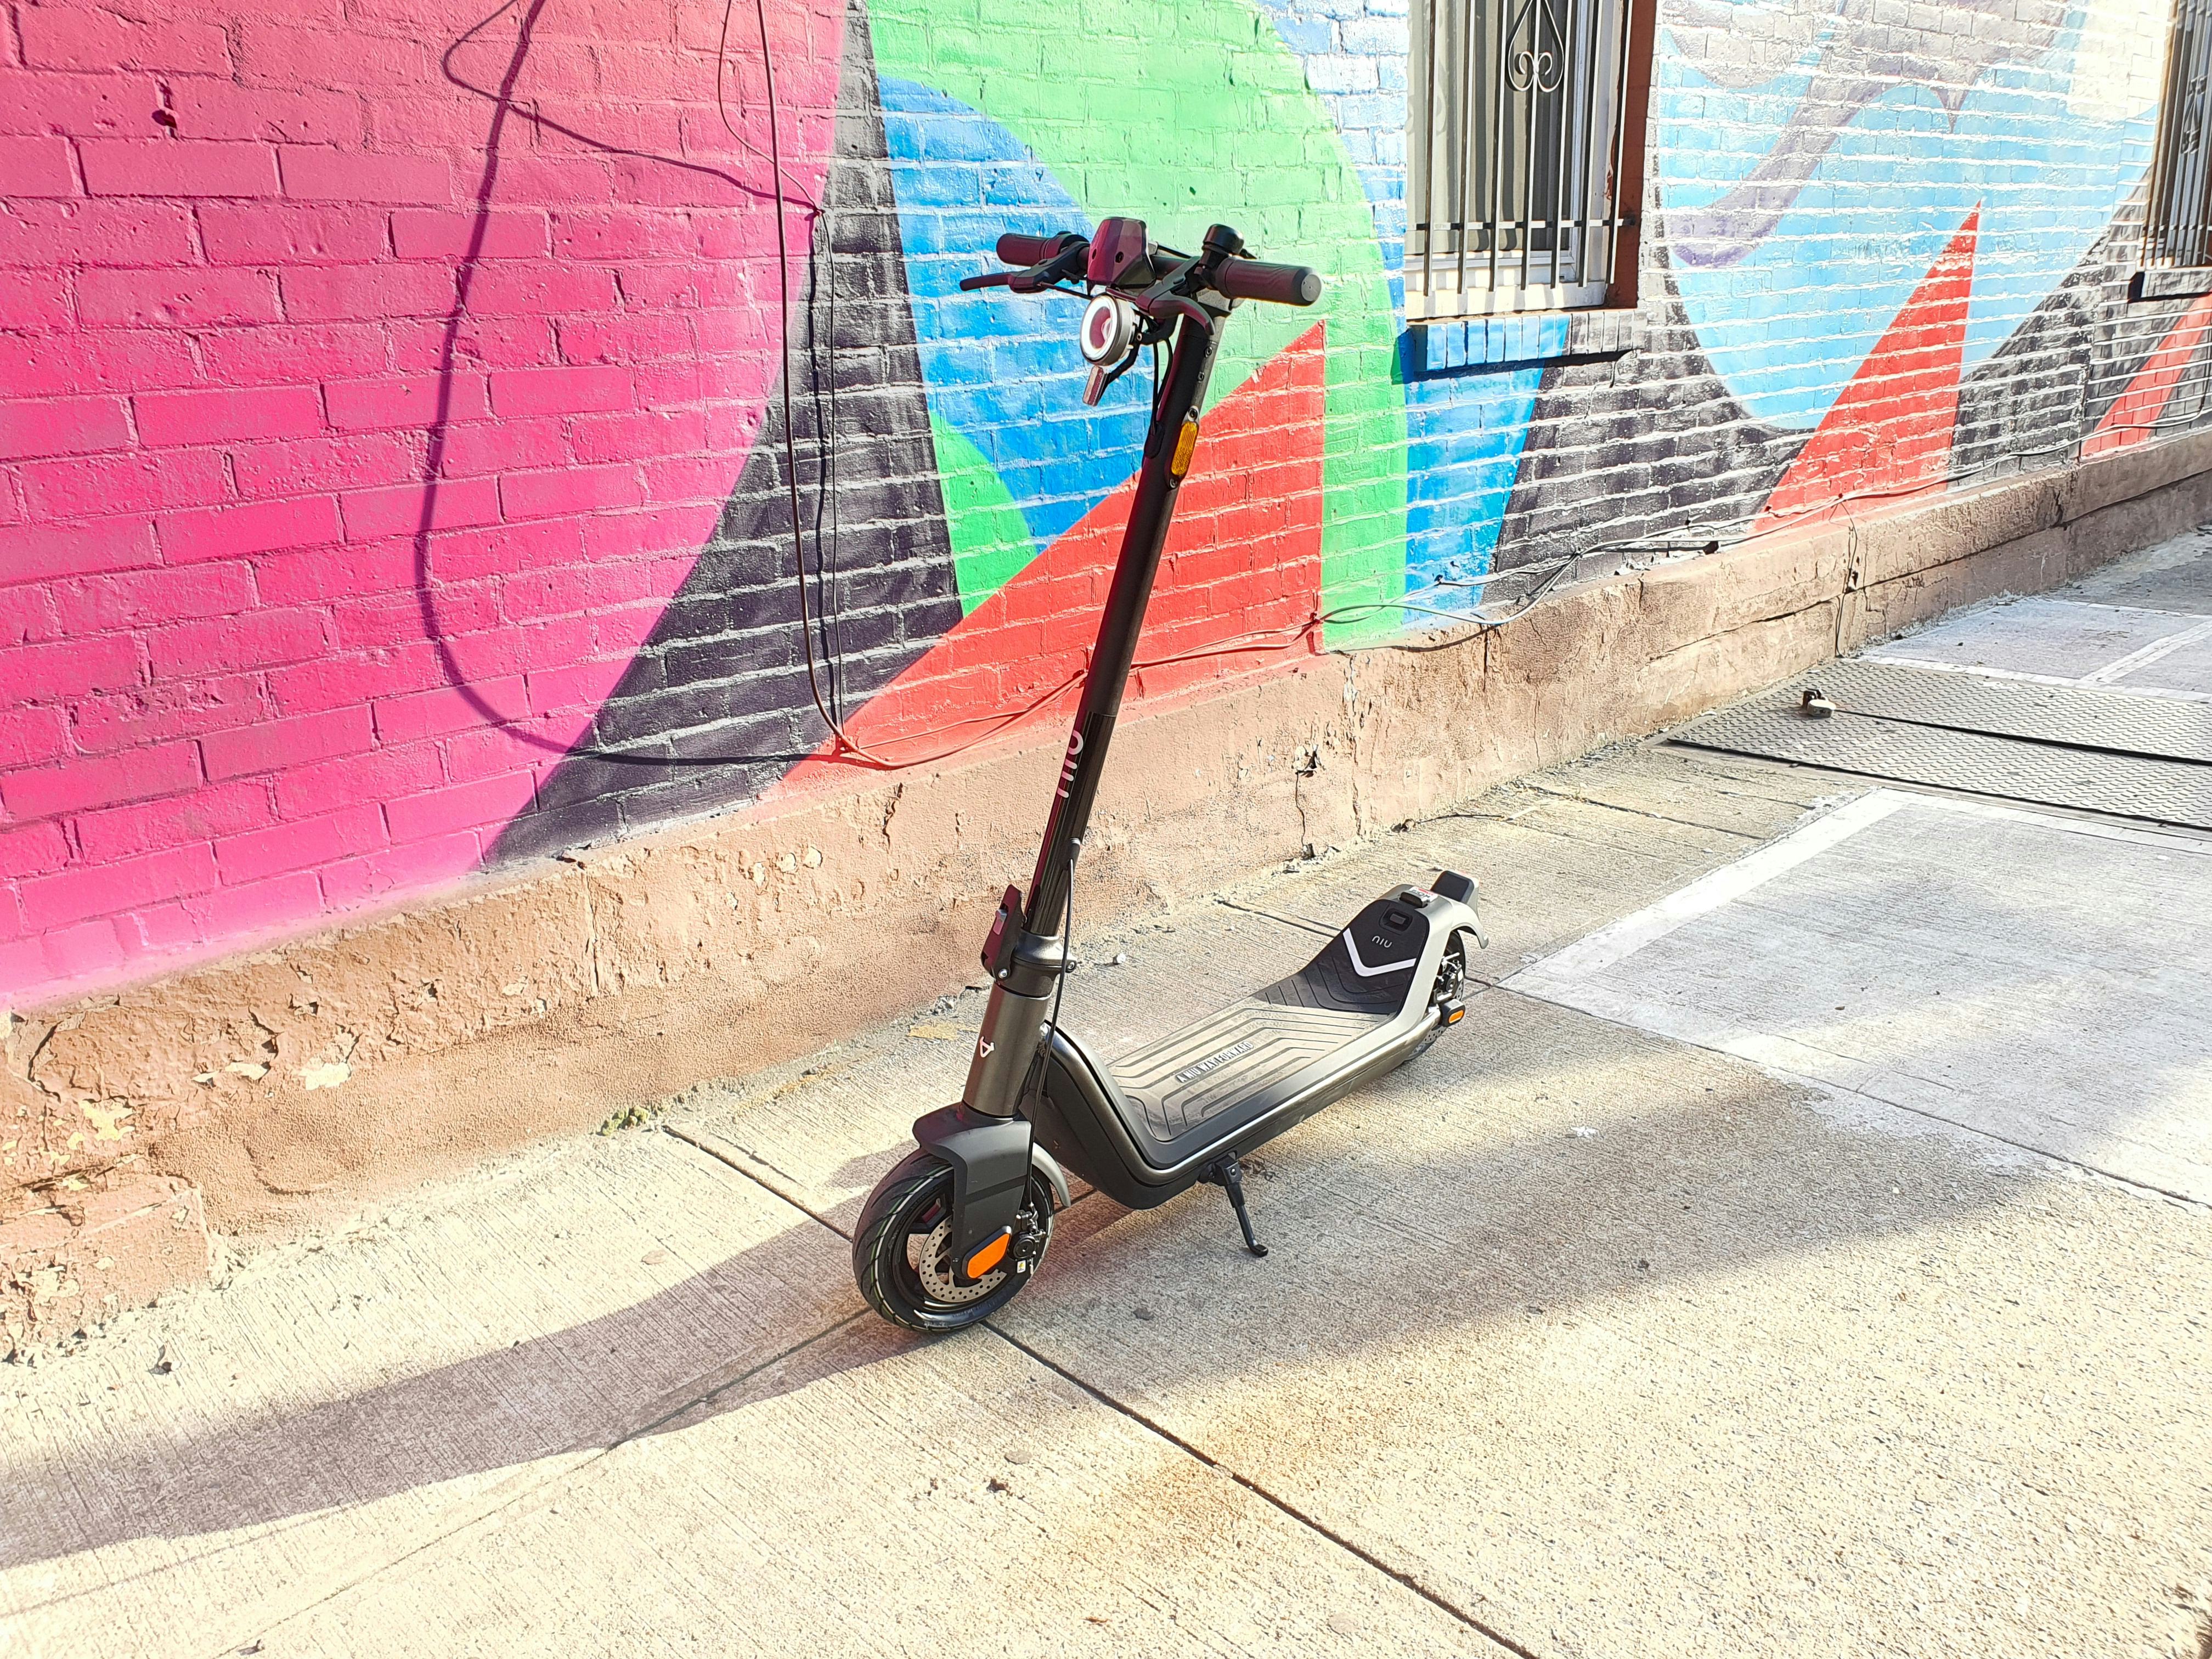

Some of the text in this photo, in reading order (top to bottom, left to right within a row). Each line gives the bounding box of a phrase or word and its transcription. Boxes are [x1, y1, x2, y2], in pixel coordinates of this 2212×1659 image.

[1176, 1041, 1254, 1083] A NIU WAY FORWARD
